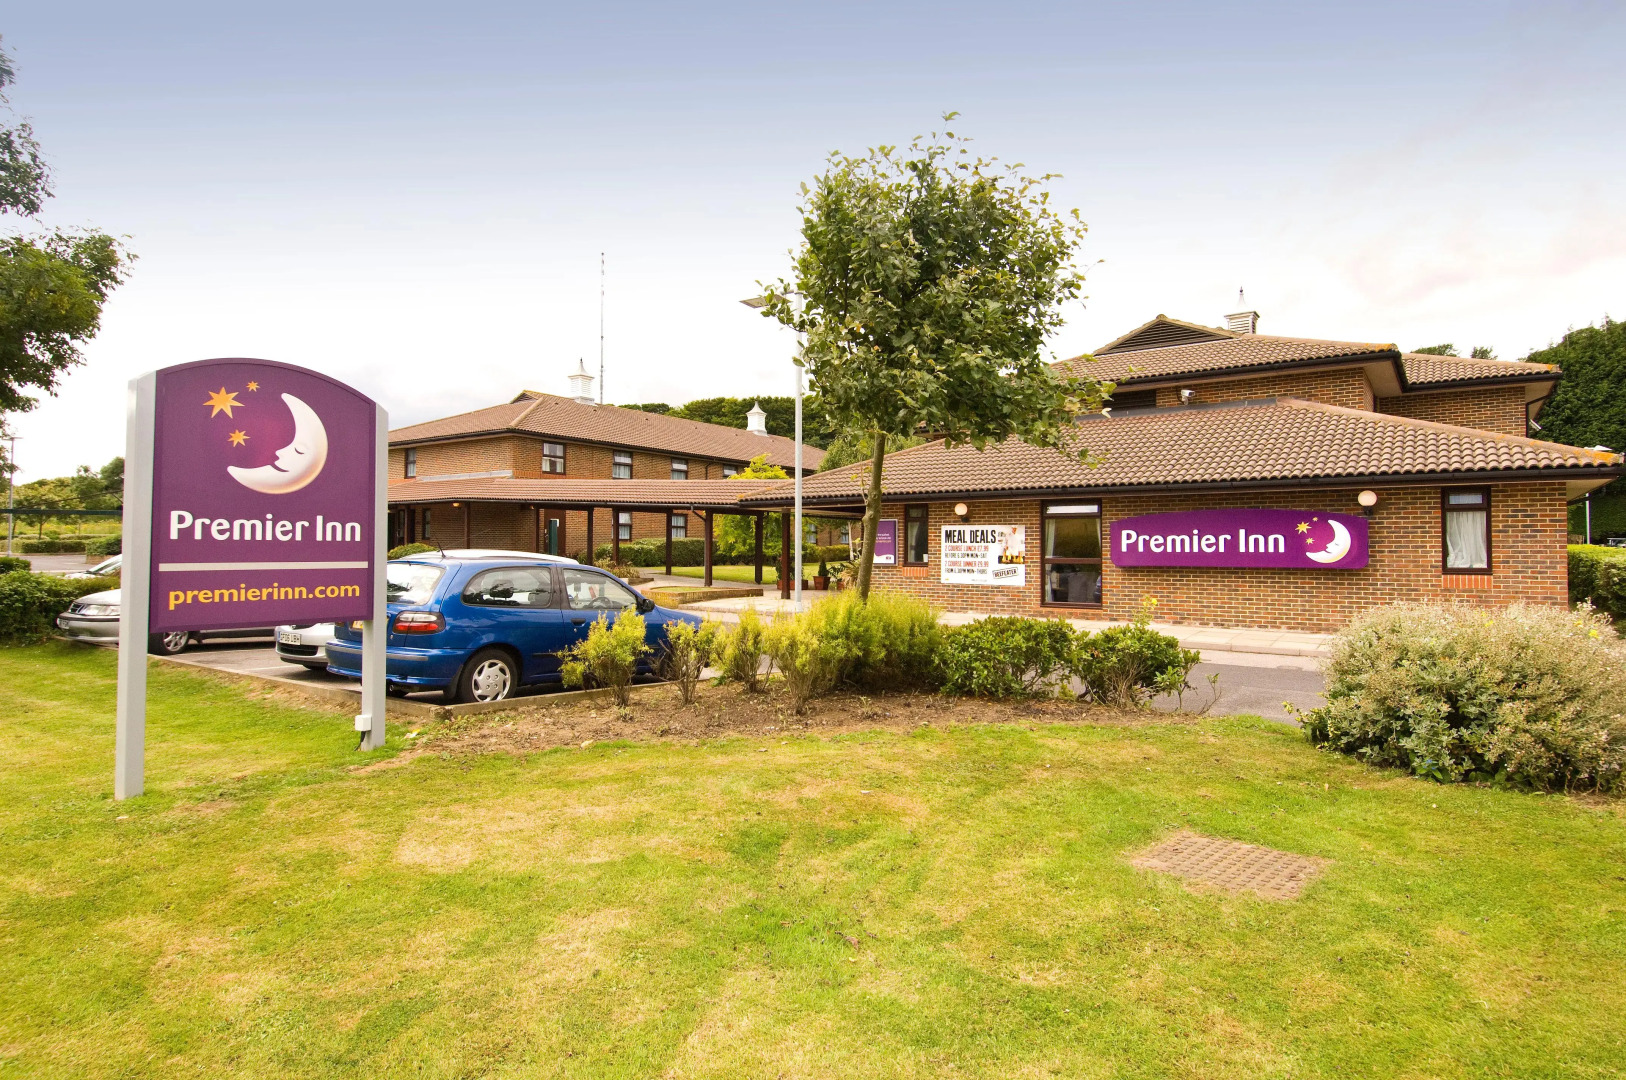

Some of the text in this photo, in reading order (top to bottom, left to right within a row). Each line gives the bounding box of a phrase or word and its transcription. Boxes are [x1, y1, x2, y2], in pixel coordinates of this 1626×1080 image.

[169, 511, 361, 542] Premier Inn
[945, 529, 967, 543] MEAL
[970, 529, 996, 543] DEALS
[1121, 529, 1285, 553] Premier Inn
[168, 583, 360, 611] premierinn.com
